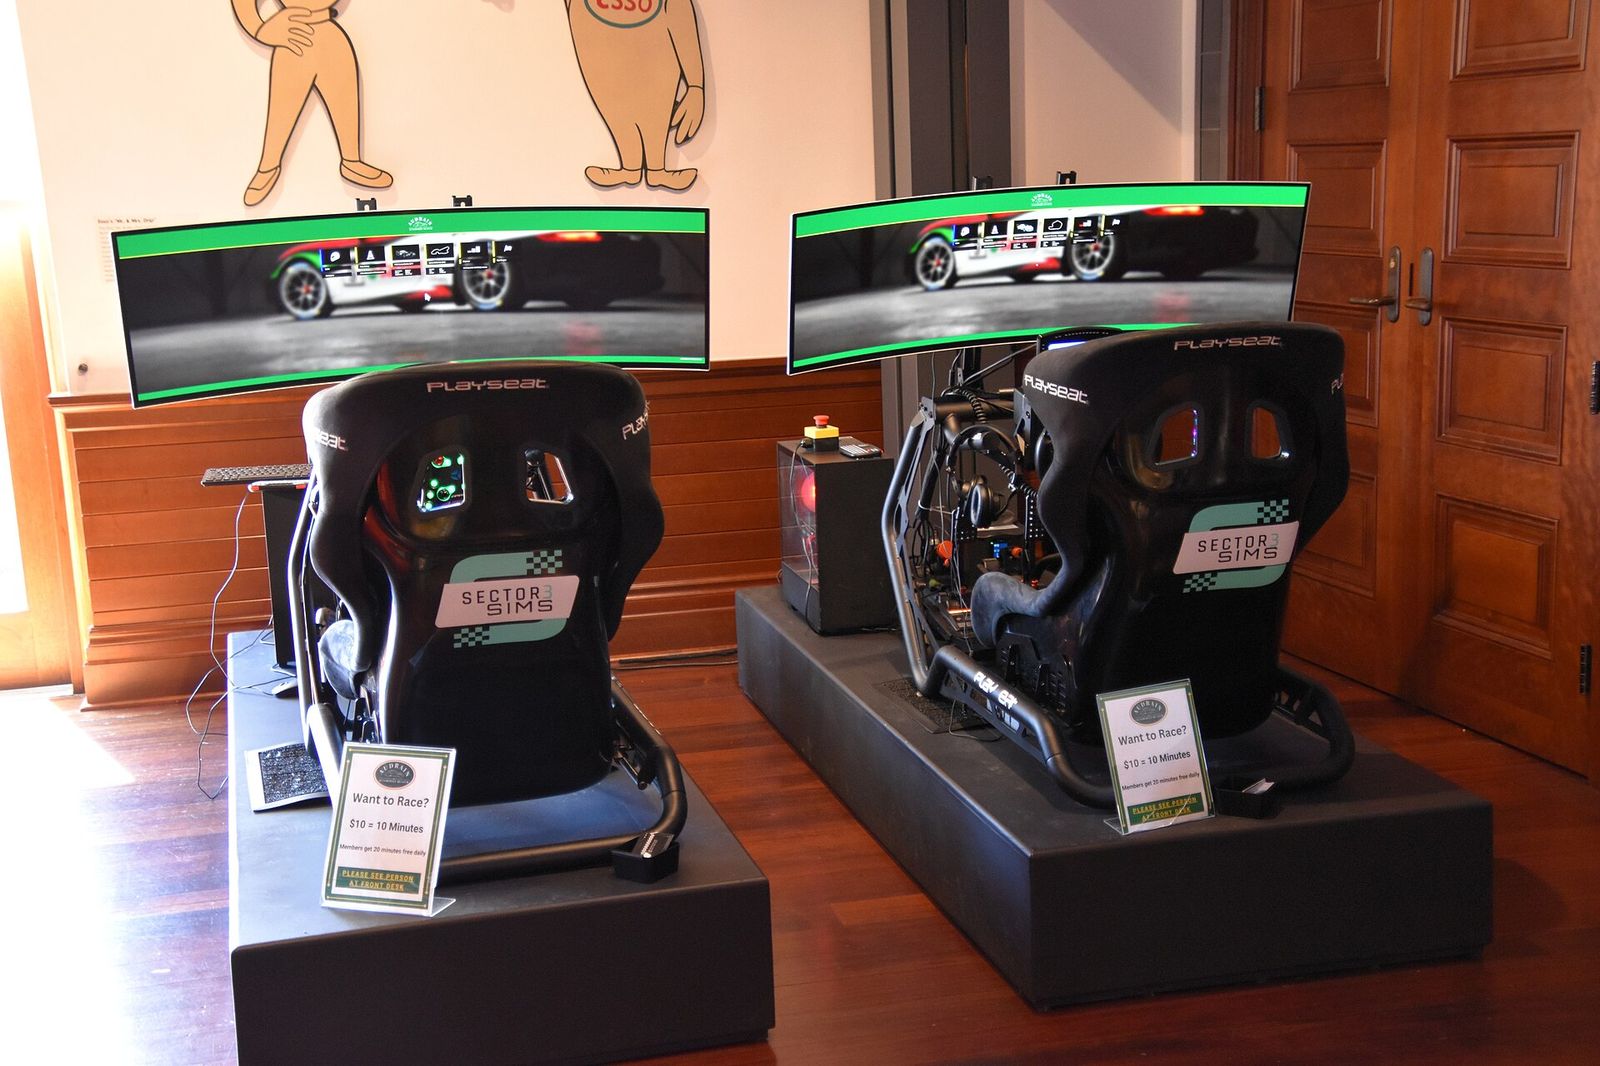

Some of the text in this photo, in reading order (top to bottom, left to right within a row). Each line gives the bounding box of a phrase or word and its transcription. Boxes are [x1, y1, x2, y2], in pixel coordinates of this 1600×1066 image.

[1197, 533, 1279, 553] SECTOR3
[1218, 546, 1278, 563] SIMS
[462, 584, 553, 605] SECTOR3
[487, 600, 552, 616] SIMS
[1118, 725, 1187, 746] Want to Race?
[1124, 759, 1139, 770] $10
[1148, 755, 1158, 765] 10
[1159, 751, 1191, 762] Minutes
[1122, 782, 1144, 791] Members
[1144, 780, 1153, 788] get
[353, 793, 429, 808] Want to Race?
[1133, 804, 1156, 814] PLEASE
[1159, 801, 1170, 809] SEE
[1153, 810, 1174, 820] FRONT
[349, 819, 366, 829] $10
[377, 822, 387, 830] 10
[389, 822, 424, 834] Minutes
[340, 843, 363, 851] Members
[414, 849, 426, 857] daily
[342, 870, 414, 882] PLEASE SEE PERSON
[360, 881, 384, 889] FRONT
[386, 883, 404, 891] DESK
